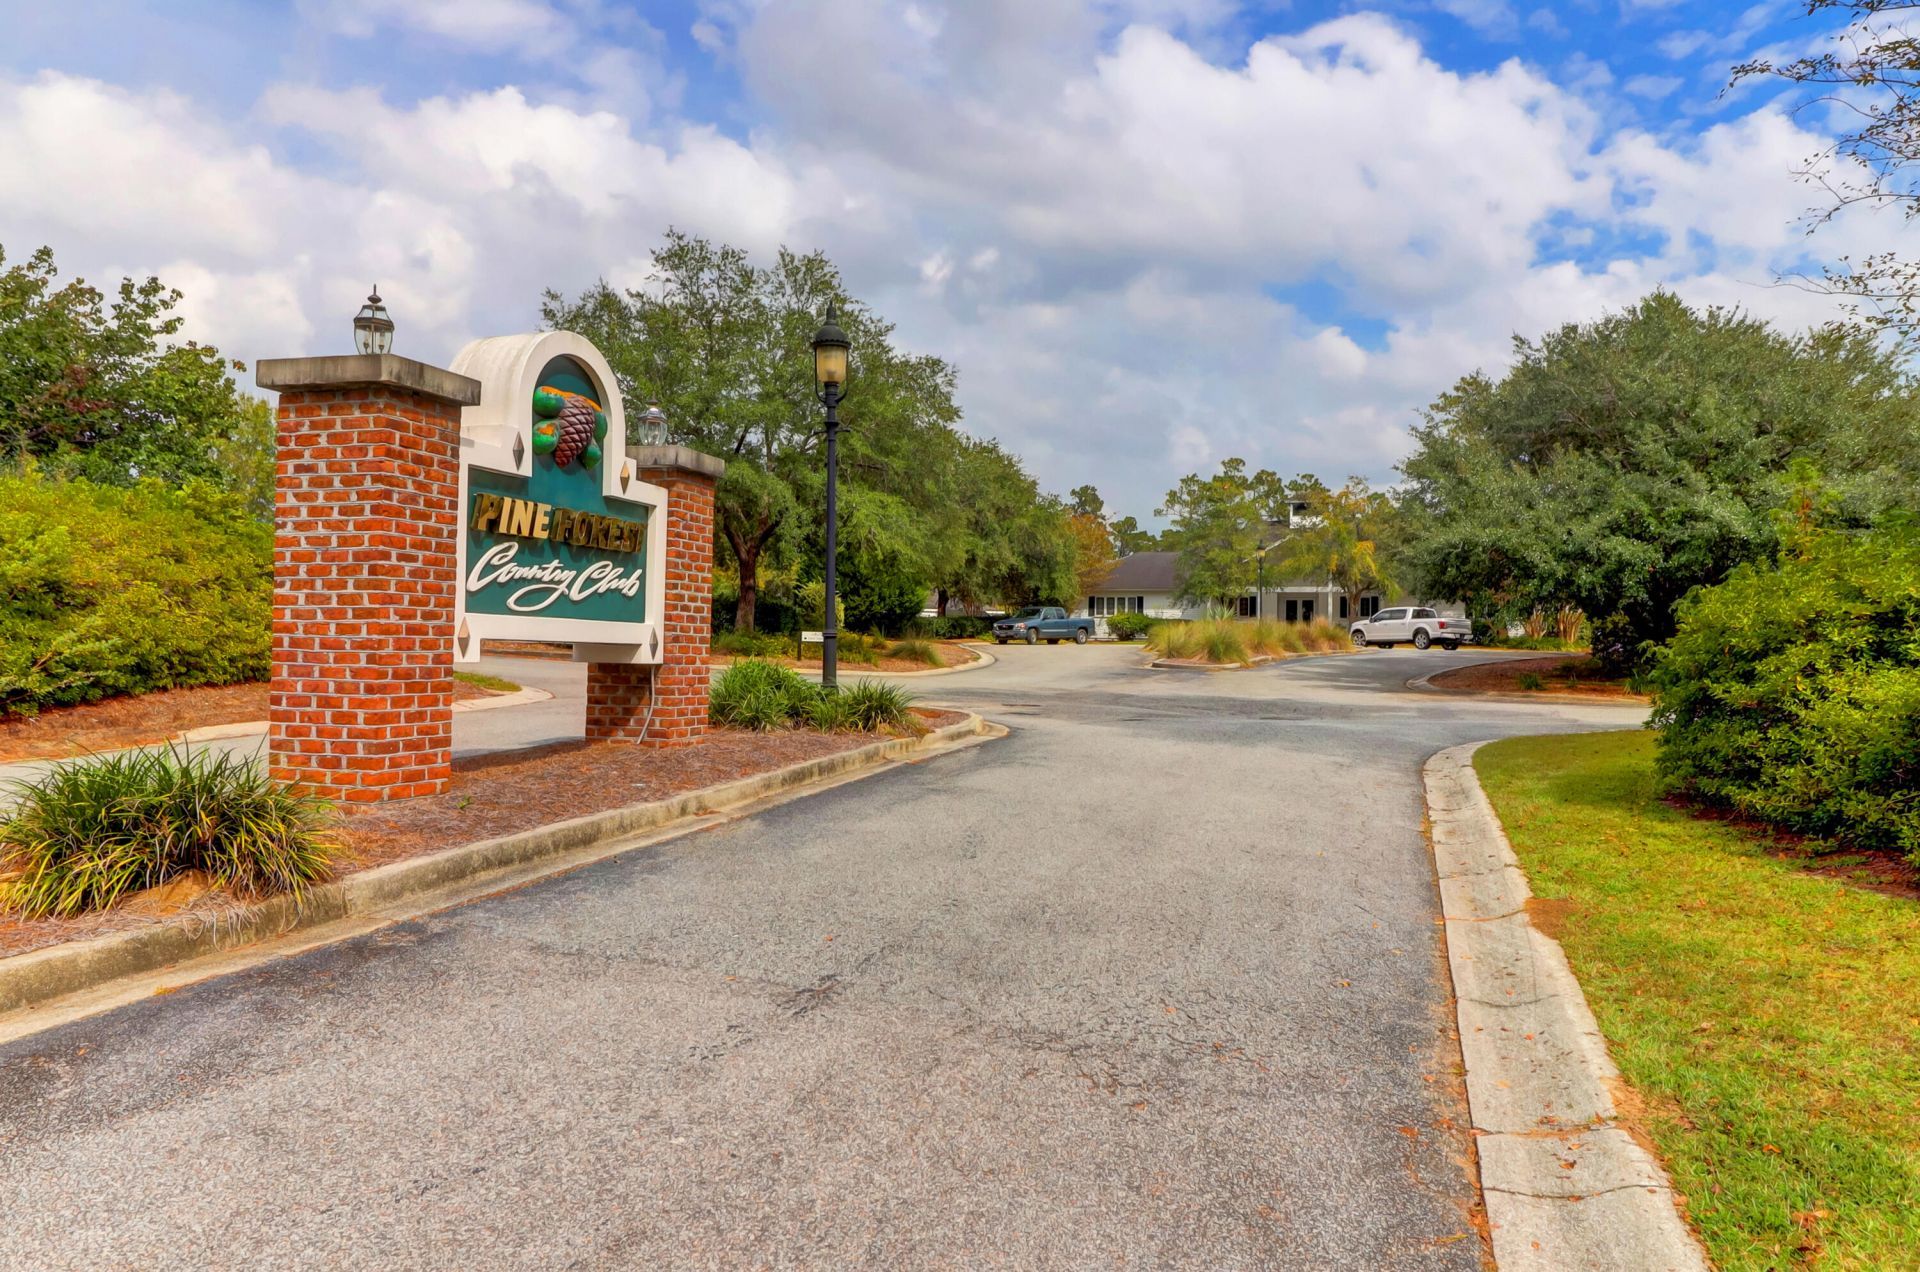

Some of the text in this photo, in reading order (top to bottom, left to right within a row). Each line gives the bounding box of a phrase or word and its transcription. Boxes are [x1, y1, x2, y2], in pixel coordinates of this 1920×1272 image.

[472, 493, 646, 553] PINE FOREST
[466, 541, 643, 612] Country Club
